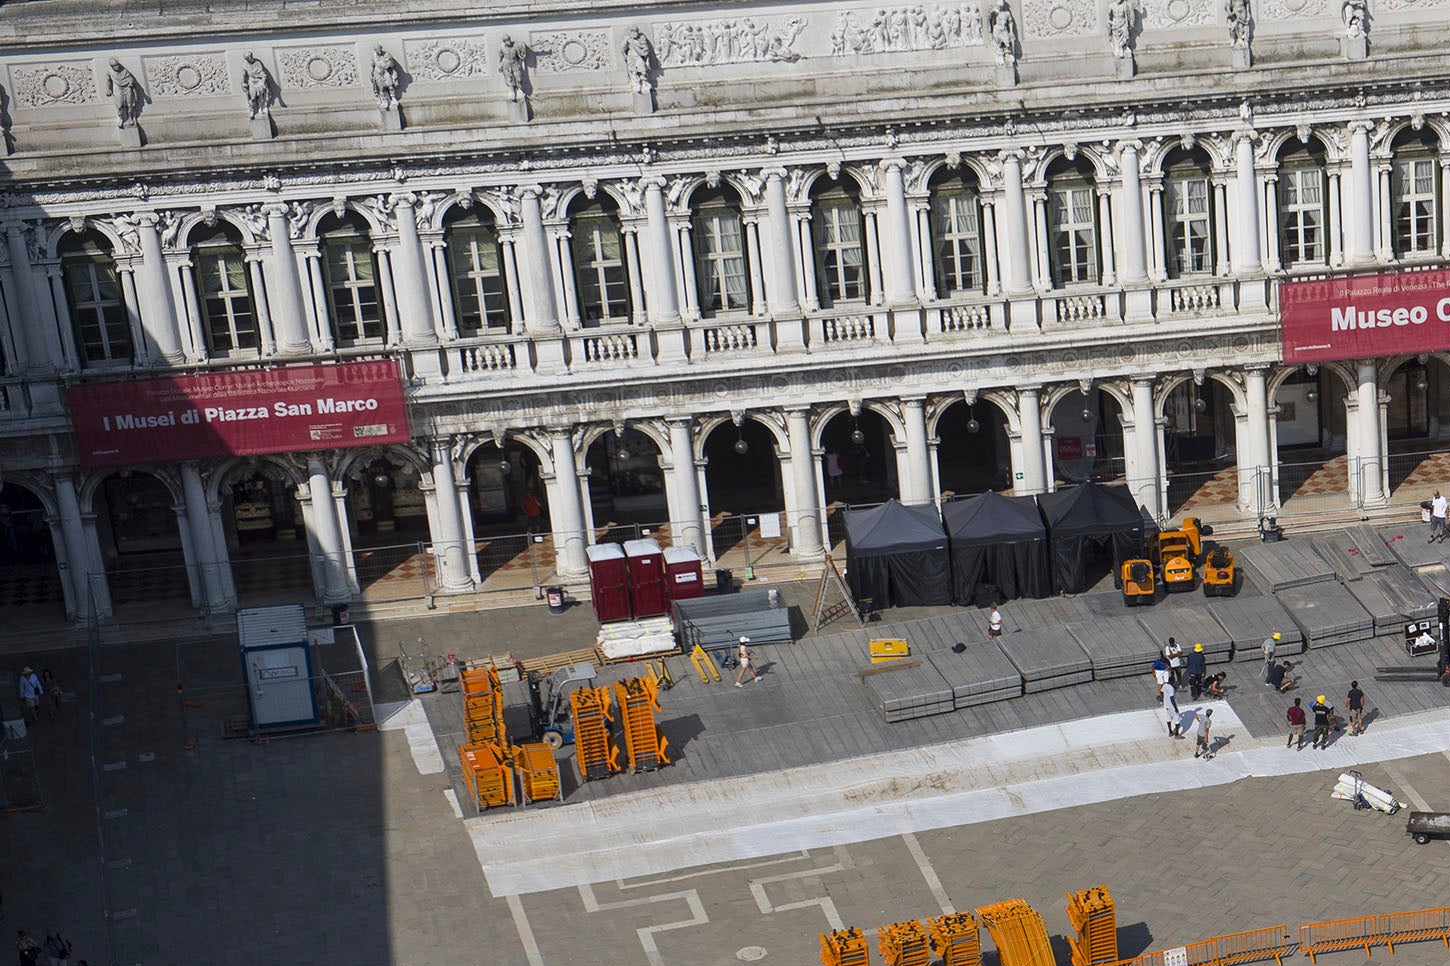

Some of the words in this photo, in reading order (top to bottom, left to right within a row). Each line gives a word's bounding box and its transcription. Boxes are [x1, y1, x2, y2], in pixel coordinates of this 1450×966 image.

[1345, 288, 1372, 297] Palazzo
[1373, 286, 1392, 295] Reale
[1401, 283, 1428, 292] Venezia
[1432, 281, 1446, 289] The
[1330, 305, 1429, 332] Museo
[103, 416, 111, 432] I
[116, 411, 176, 431] Musei
[181, 409, 200, 425] di
[204, 406, 270, 423] Piazza
[274, 401, 313, 418] San
[317, 398, 379, 414] Marco
